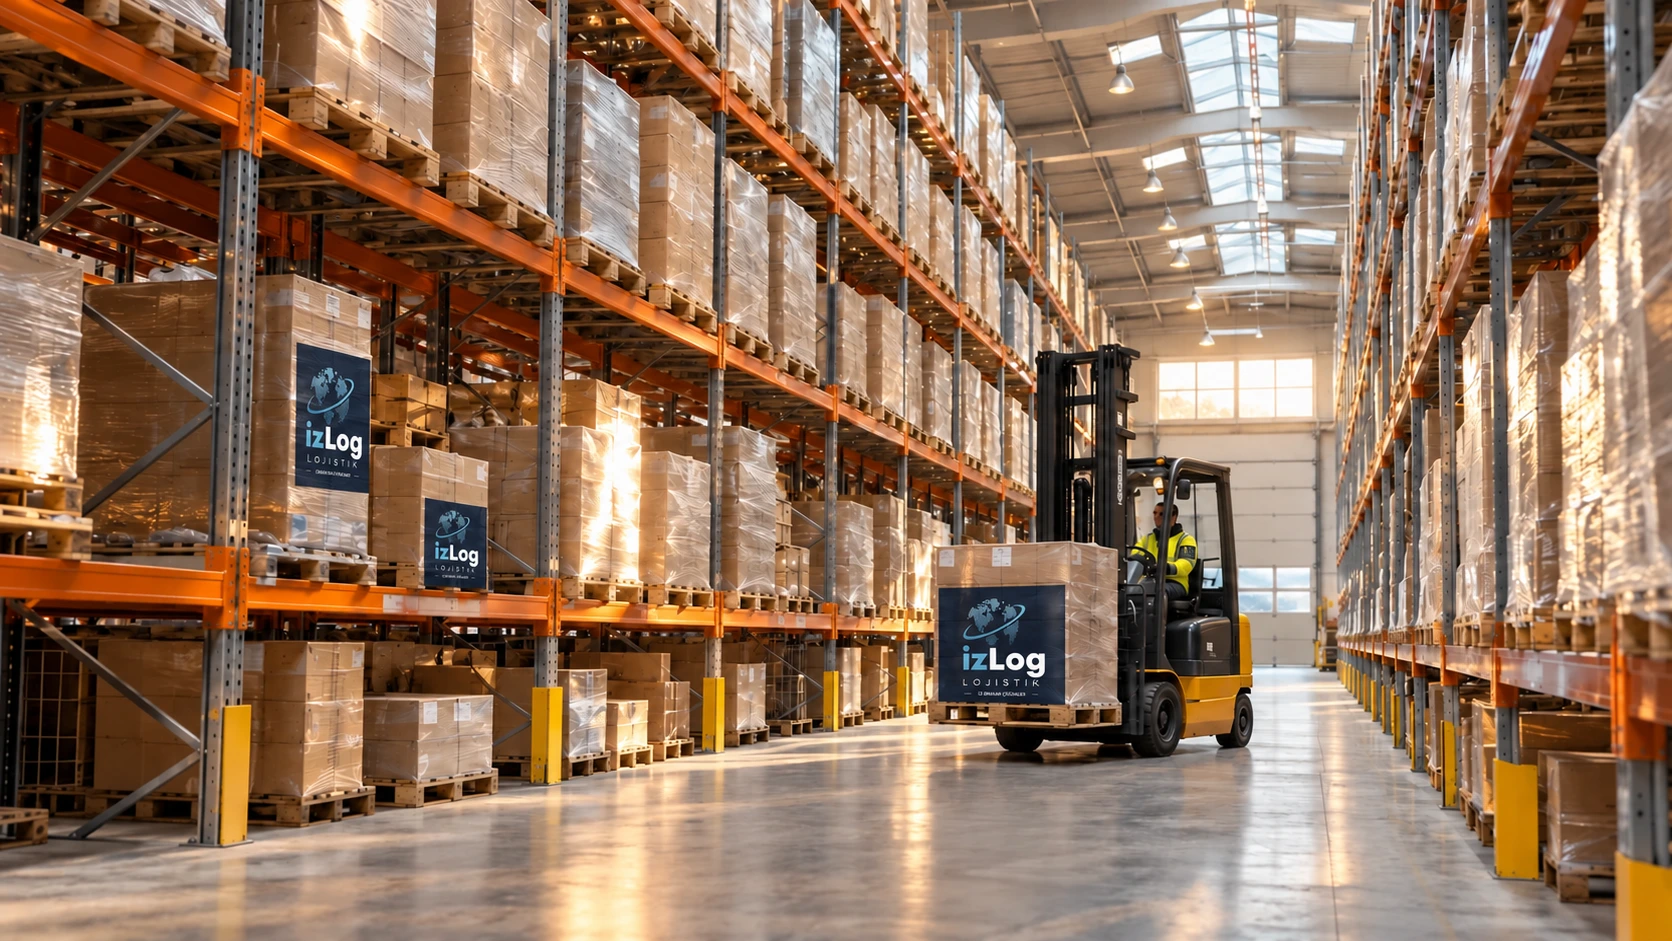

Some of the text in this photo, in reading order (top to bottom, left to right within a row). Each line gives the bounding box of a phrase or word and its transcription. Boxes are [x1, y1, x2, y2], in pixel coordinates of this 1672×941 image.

[305, 420, 363, 460] izLog
[434, 541, 479, 567] izLog
[962, 644, 1046, 678] izLog
